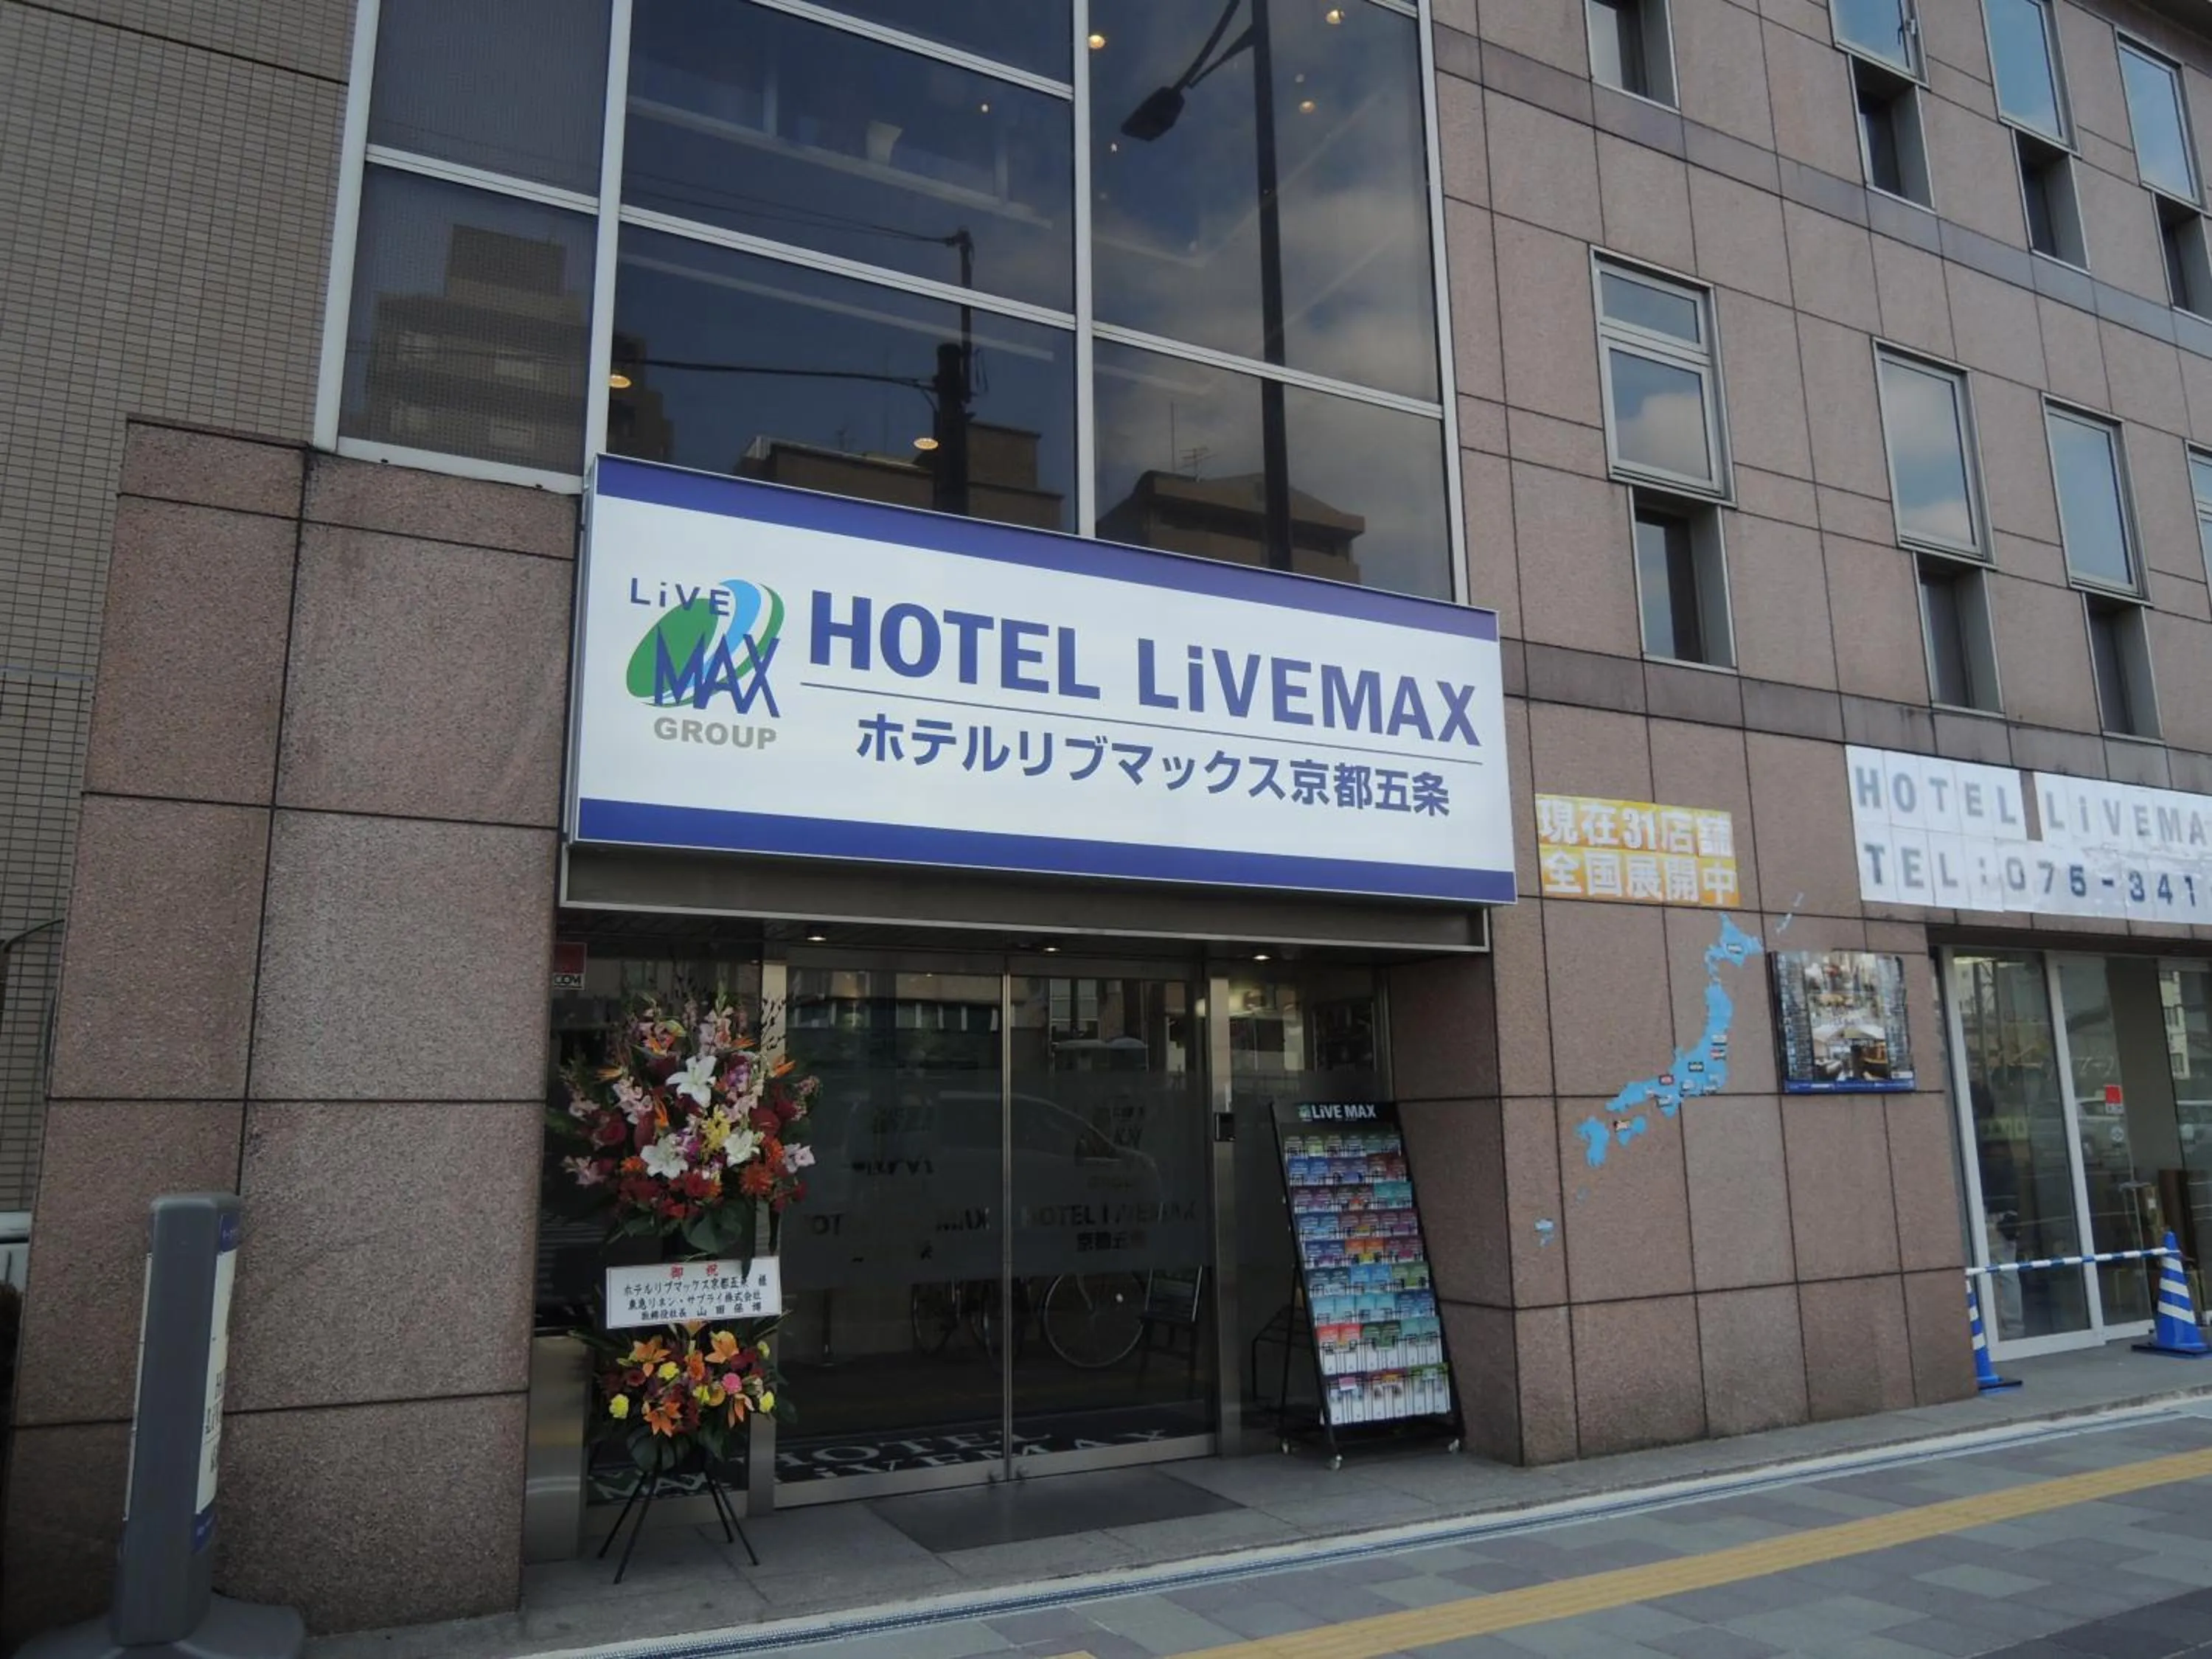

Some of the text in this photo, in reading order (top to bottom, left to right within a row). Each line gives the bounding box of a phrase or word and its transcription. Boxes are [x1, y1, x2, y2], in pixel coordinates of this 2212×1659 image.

[630, 577, 730, 615] LiVE
[654, 625, 781, 719] MAX
[811, 589, 1481, 747] HOTEL LiVEMAX
[653, 717, 777, 750] GROUP
[856, 713, 1450, 816] ホテルリブマックス京都五条
[1537, 799, 1733, 858] 現在31店舗
[1855, 765, 2212, 847] HOTEL LiVEMA
[1543, 850, 1738, 906] 全国展開中
[1344, 1105, 1377, 1119] MAX
